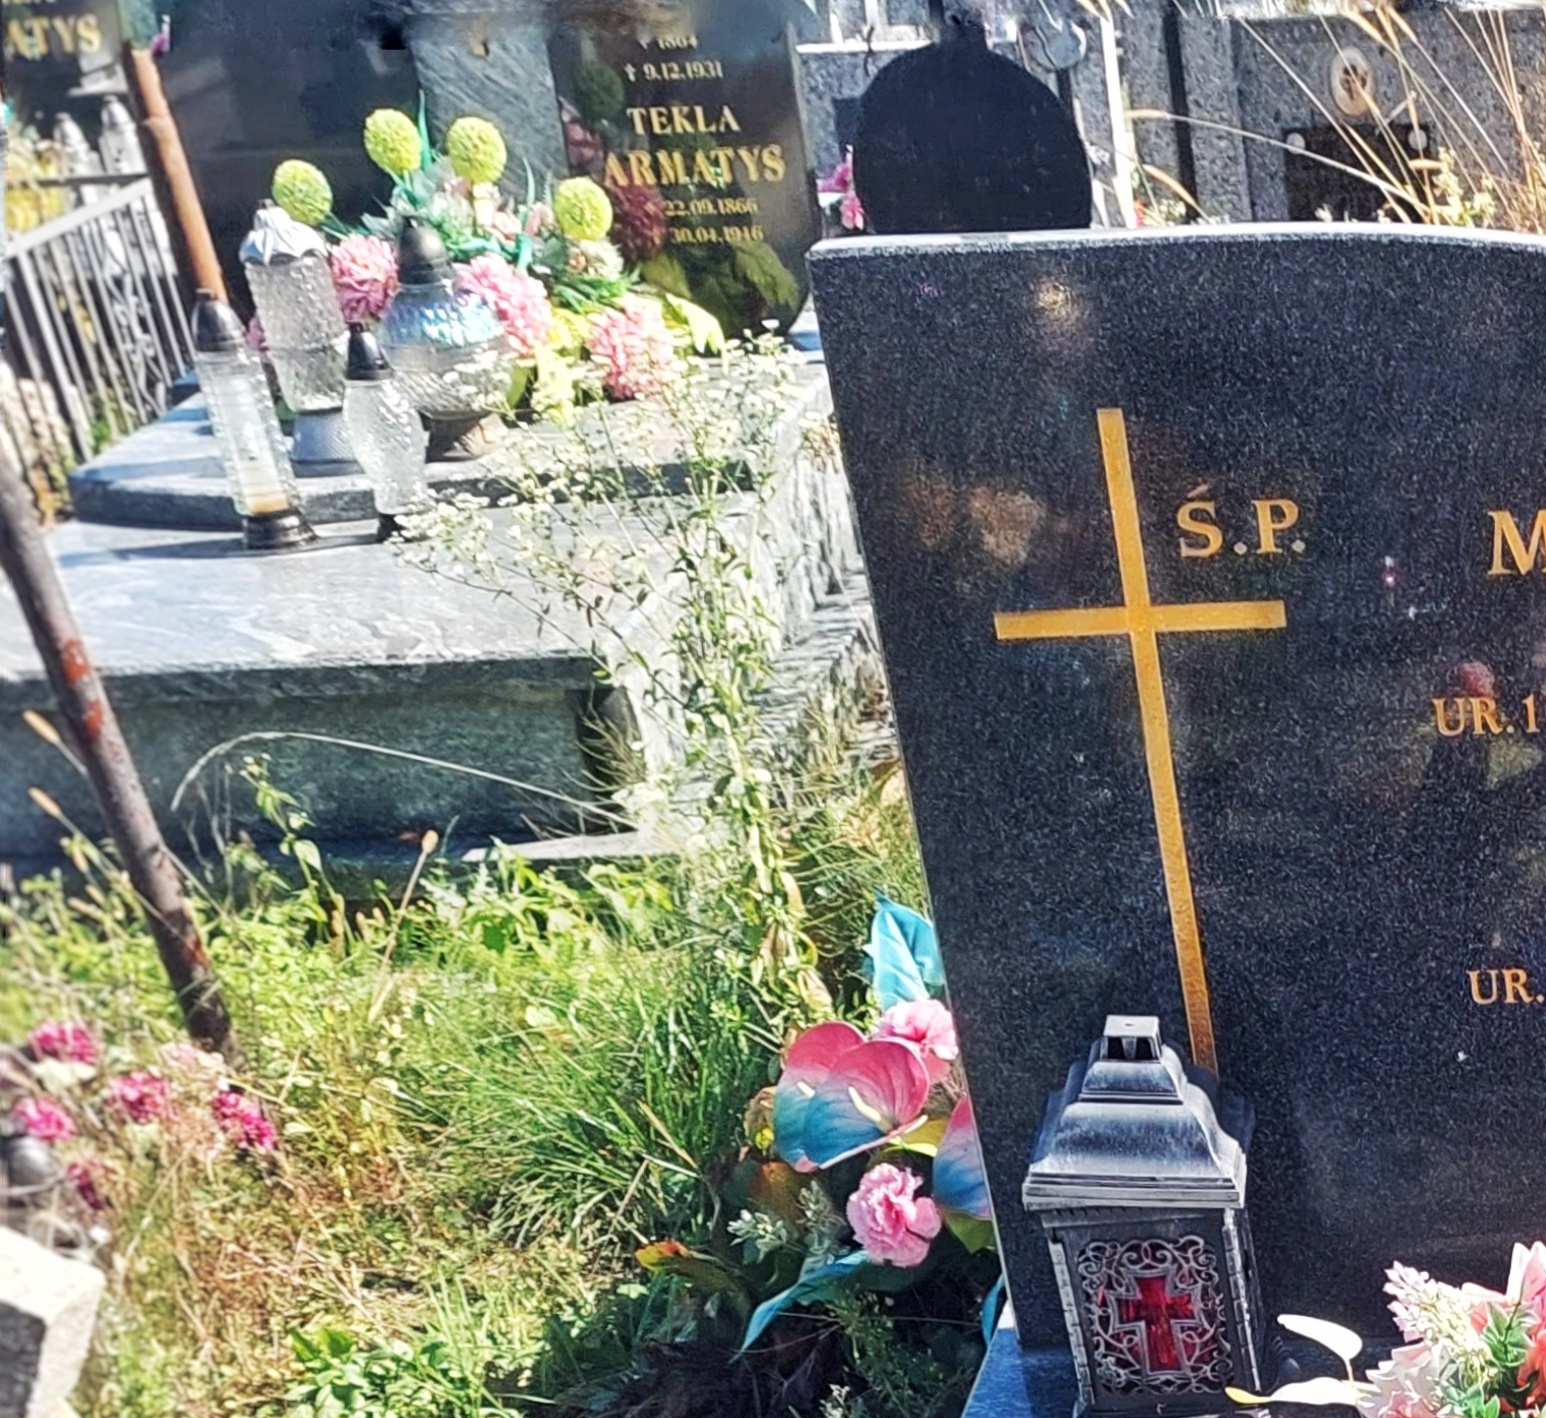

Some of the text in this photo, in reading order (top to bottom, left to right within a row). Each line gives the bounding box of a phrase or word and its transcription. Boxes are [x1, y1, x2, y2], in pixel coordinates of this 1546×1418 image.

[626, 105, 741, 136] TEKLA
[605, 143, 786, 189] ARMATYS
[1176, 484, 1306, 557] Ś.P.
